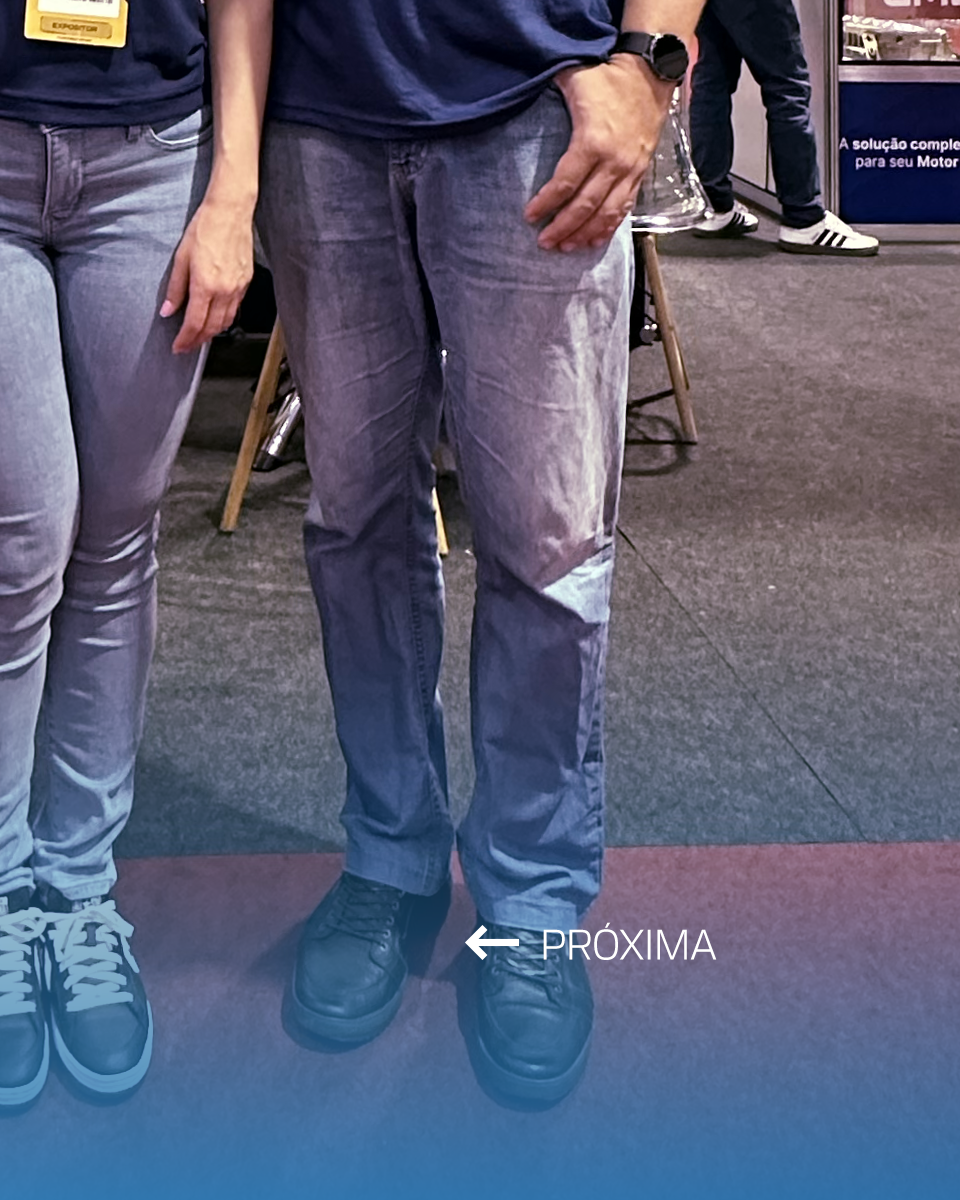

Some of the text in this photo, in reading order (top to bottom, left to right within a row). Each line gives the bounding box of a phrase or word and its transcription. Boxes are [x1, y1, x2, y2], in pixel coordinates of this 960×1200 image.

[839, 137, 849, 150] A
[852, 137, 908, 153] solução
[855, 155, 959, 170] para seu Motor
